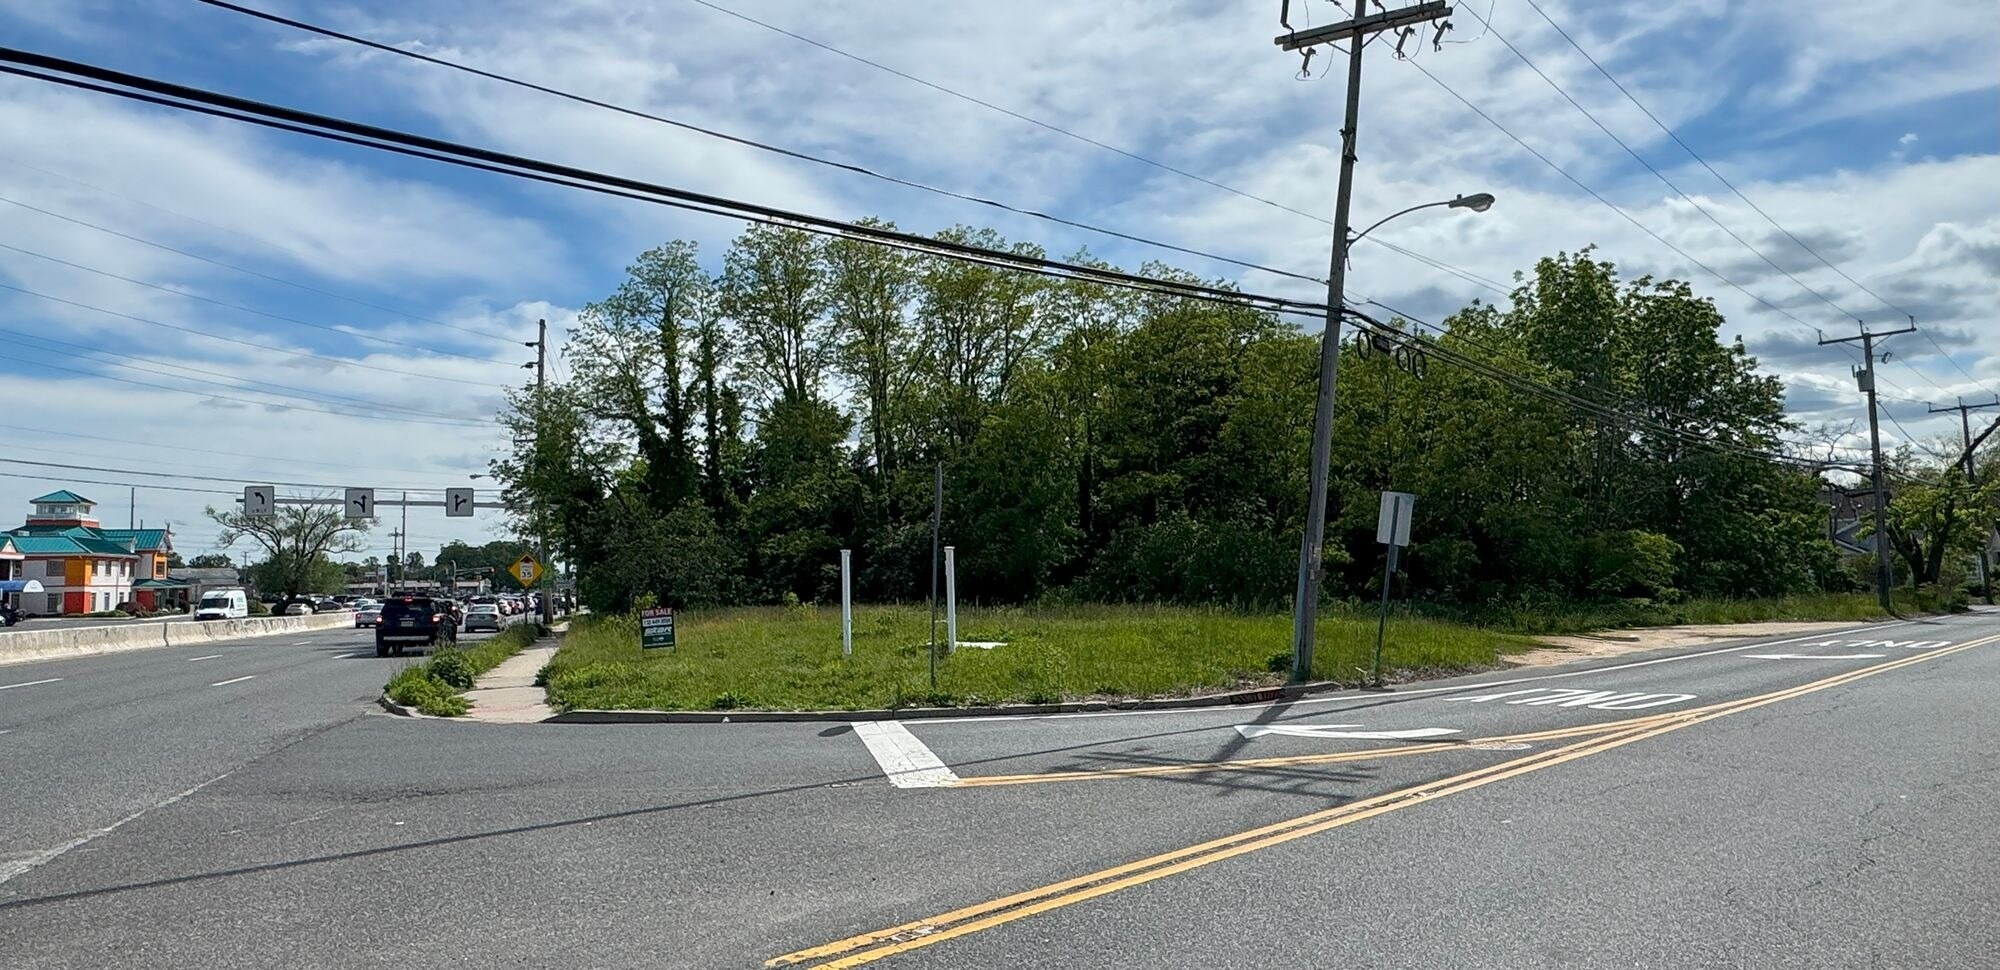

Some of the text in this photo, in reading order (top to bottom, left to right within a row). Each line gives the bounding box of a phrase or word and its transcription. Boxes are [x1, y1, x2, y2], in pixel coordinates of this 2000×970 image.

[641, 607, 672, 617] FOR SALE
[1799, 640, 1952, 648] ONLY
[1443, 688, 1697, 710] ONLY
